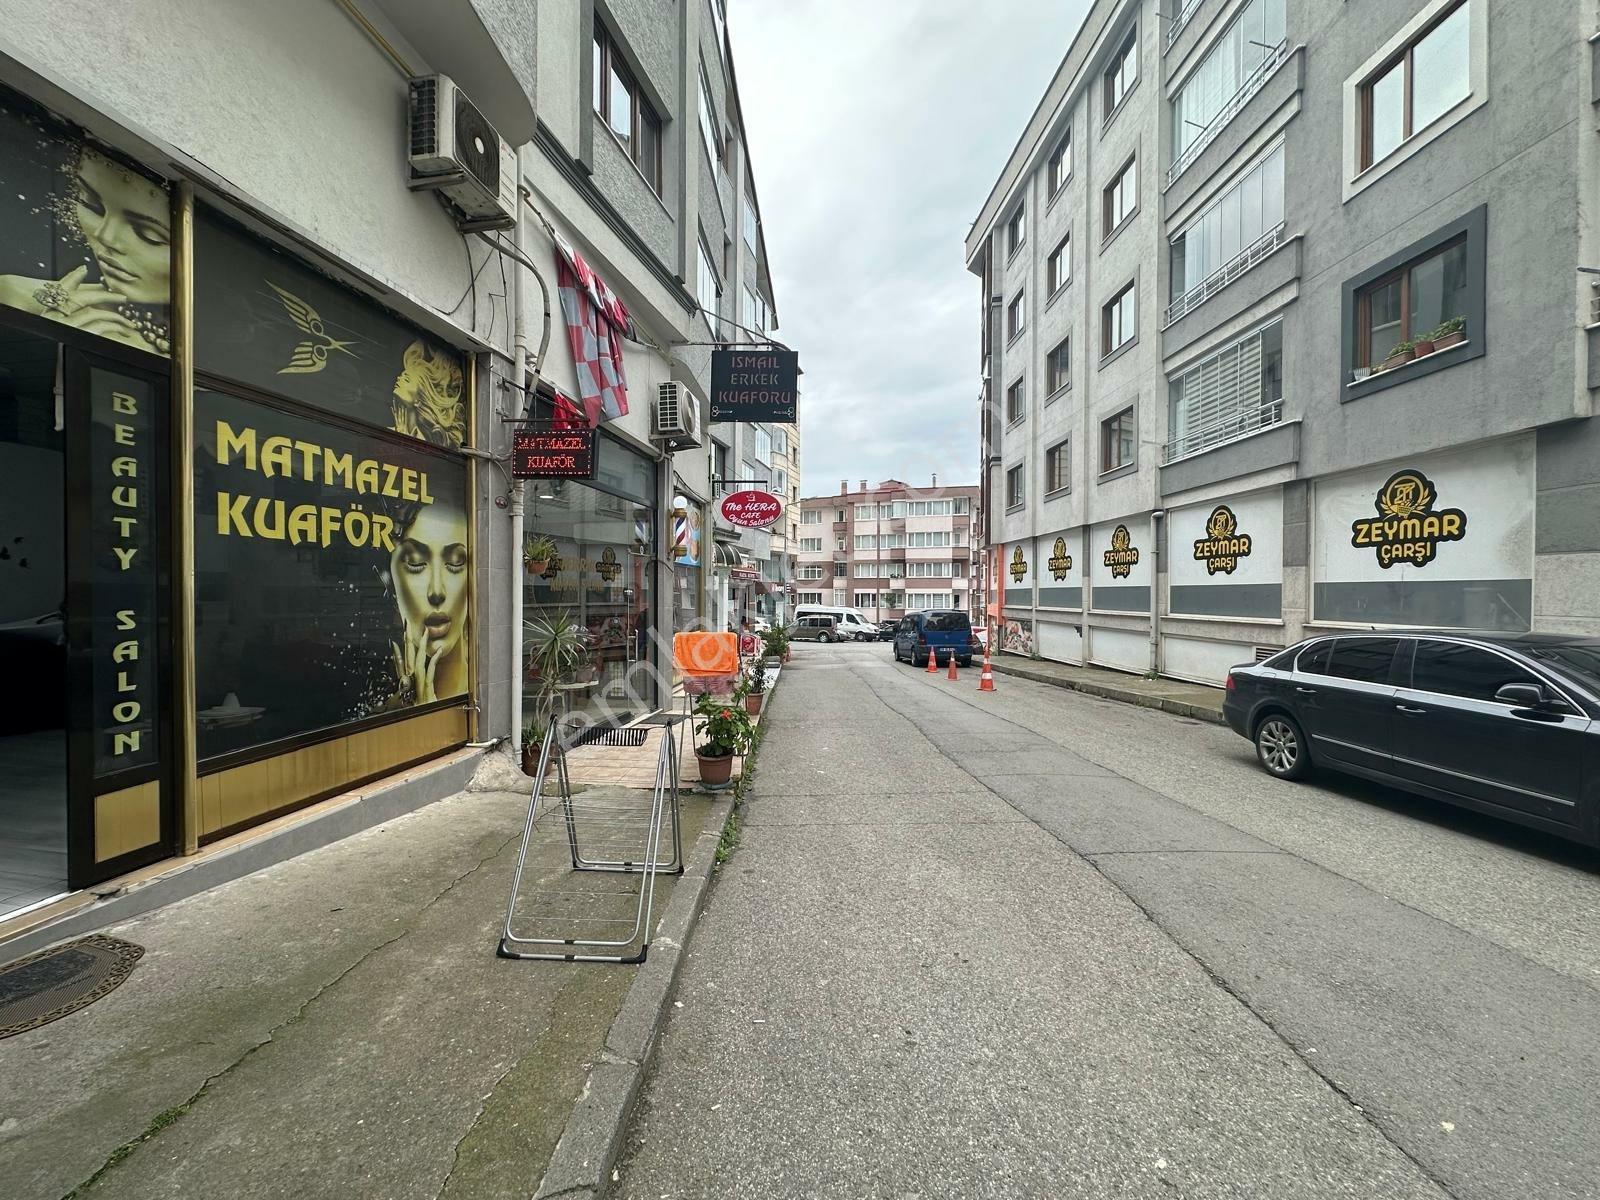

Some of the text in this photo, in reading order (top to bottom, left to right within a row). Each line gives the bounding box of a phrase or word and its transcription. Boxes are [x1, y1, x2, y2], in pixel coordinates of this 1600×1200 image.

[731, 373, 779, 386] ERKEK
[216, 420, 434, 504] MATMAZEL
[527, 454, 576, 468] KUAFÖR
[725, 502, 777, 511] The HERA
[217, 492, 395, 552] KUAFÖR
[1356, 514, 1461, 543] ZEYMAR
[1195, 538, 1249, 556] ZEYMAR
[1381, 542, 1431, 563] ÇARŞI
[1049, 557, 1072, 569] ZEYMAR
[1104, 551, 1137, 564] ZEYMAR
[1209, 557, 1235, 571] ÇARŞI
[112, 392, 141, 756] BEAUTY SALON
[1113, 565, 1129, 576] ÇARŞI
